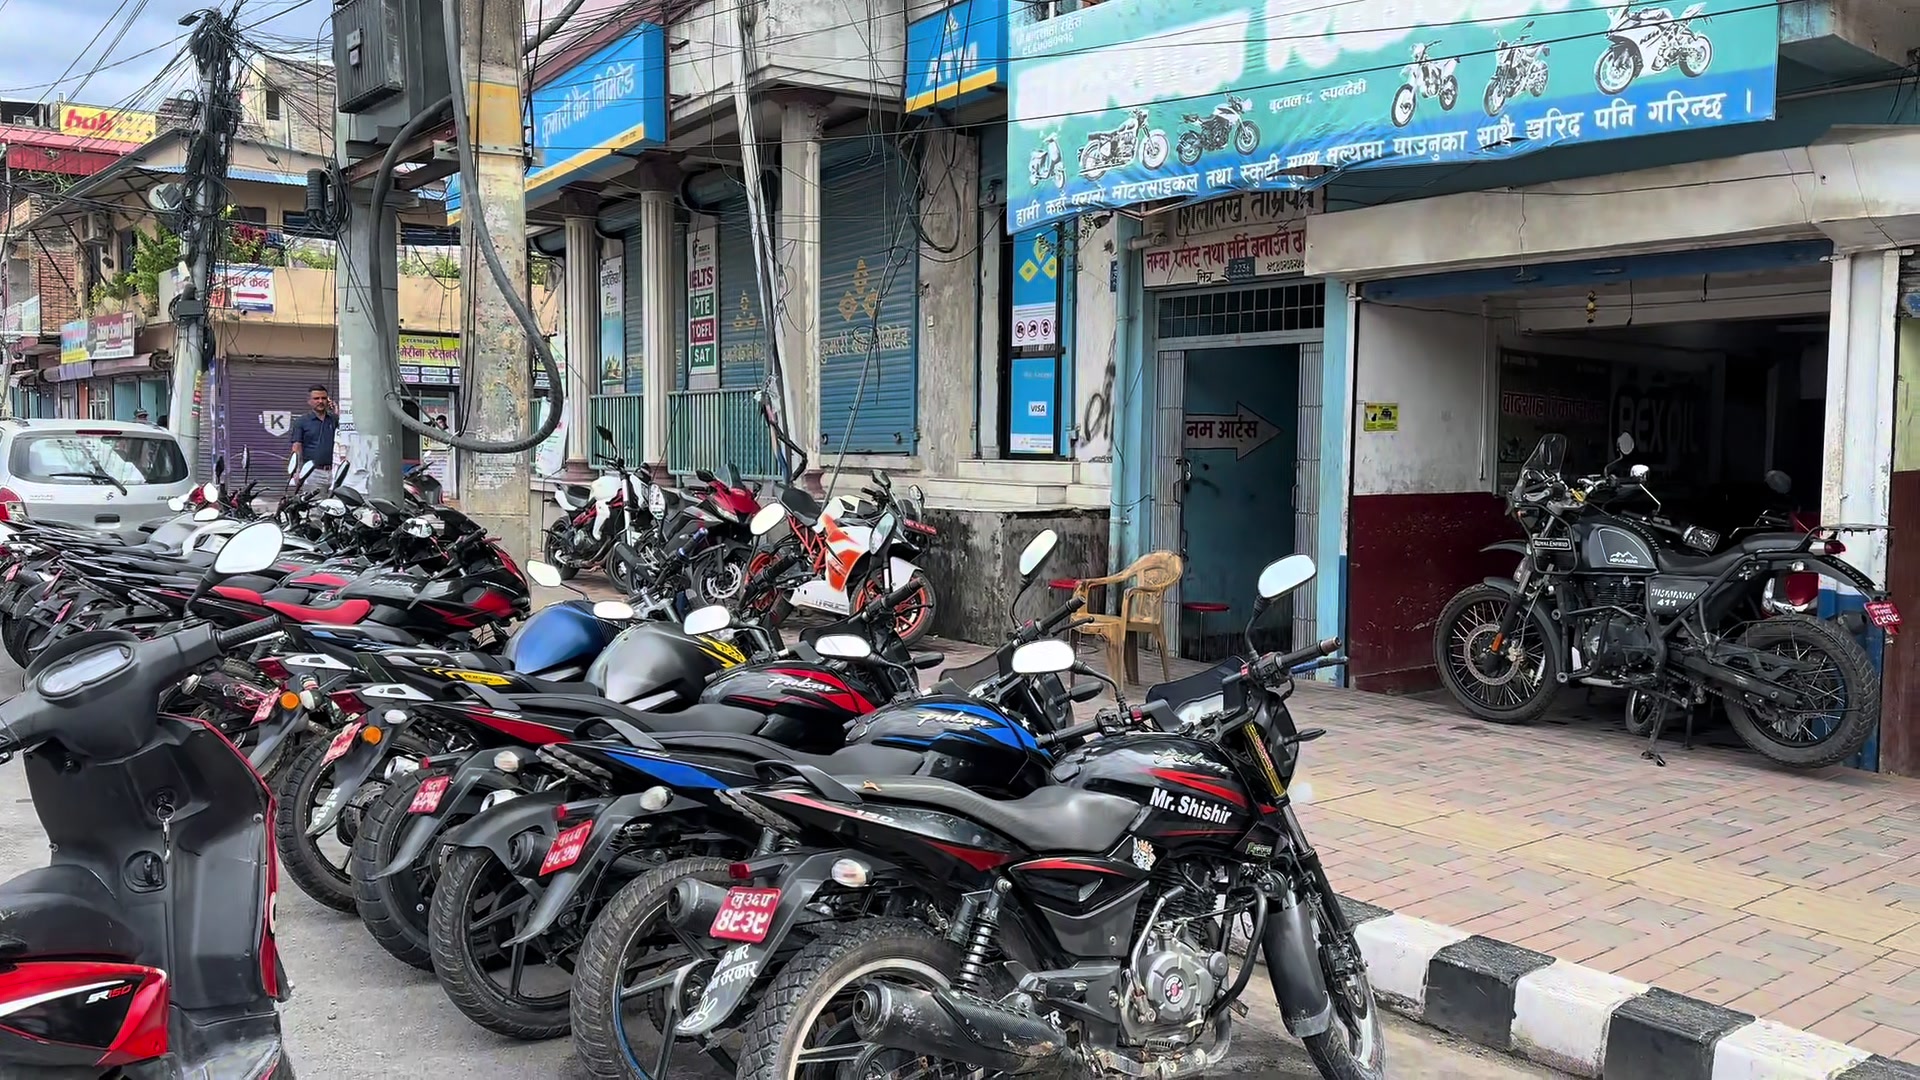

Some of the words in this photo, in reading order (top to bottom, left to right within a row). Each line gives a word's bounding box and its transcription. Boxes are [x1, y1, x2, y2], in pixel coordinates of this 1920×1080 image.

[925, 41, 978, 87] ATM
[1016, 199, 1041, 227] हामी
[1206, 166, 1233, 189] तथा
[1393, 130, 1468, 161] पाउनुका
[1525, 107, 1585, 139] खरिद
[1594, 97, 1637, 130] पनि
[1647, 89, 1727, 125] गरिन्छ
[690, 266, 714, 289] IELTS
[694, 347, 711, 363] SAT
[1030, 403, 1046, 413] VISA
[1187, 421, 1215, 439] नम
[1150, 787, 1176, 812] Mr.
[1177, 796, 1233, 825] Shishir
